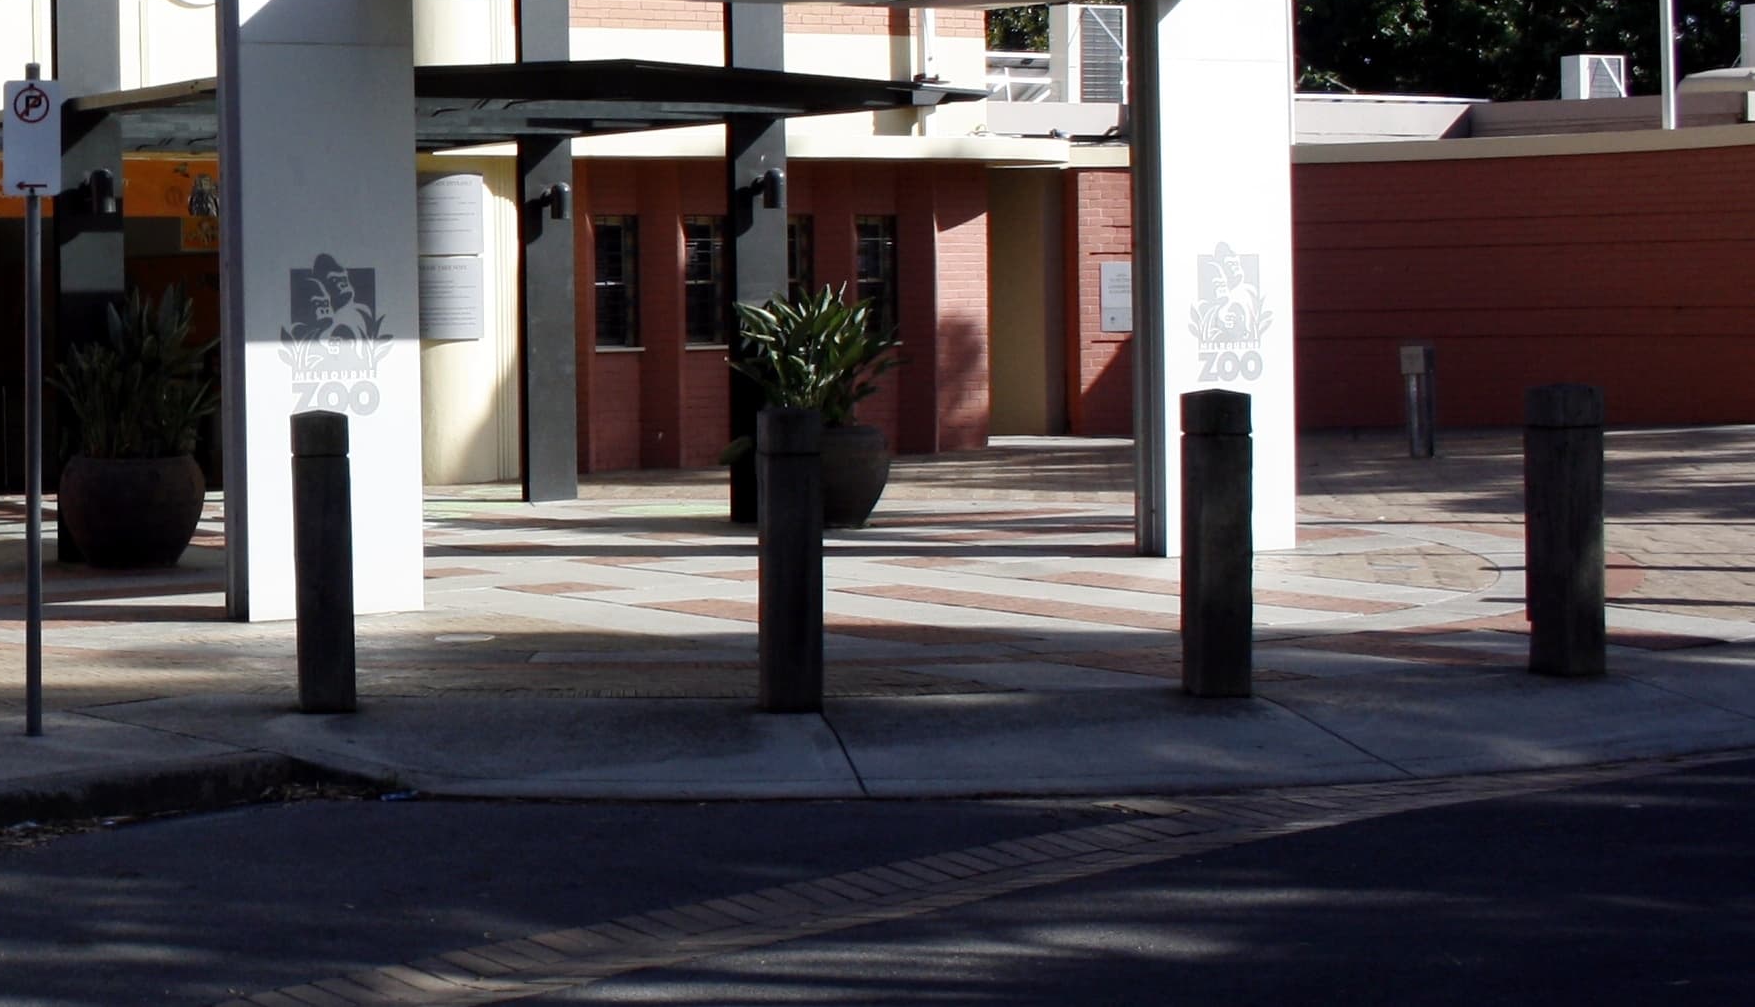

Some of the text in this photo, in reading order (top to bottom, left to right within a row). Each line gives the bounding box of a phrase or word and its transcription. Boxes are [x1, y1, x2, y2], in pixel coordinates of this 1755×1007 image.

[295, 369, 375, 380] MELBOURNE
[1198, 351, 1263, 382] ZOO
[292, 380, 380, 416] ZOO
